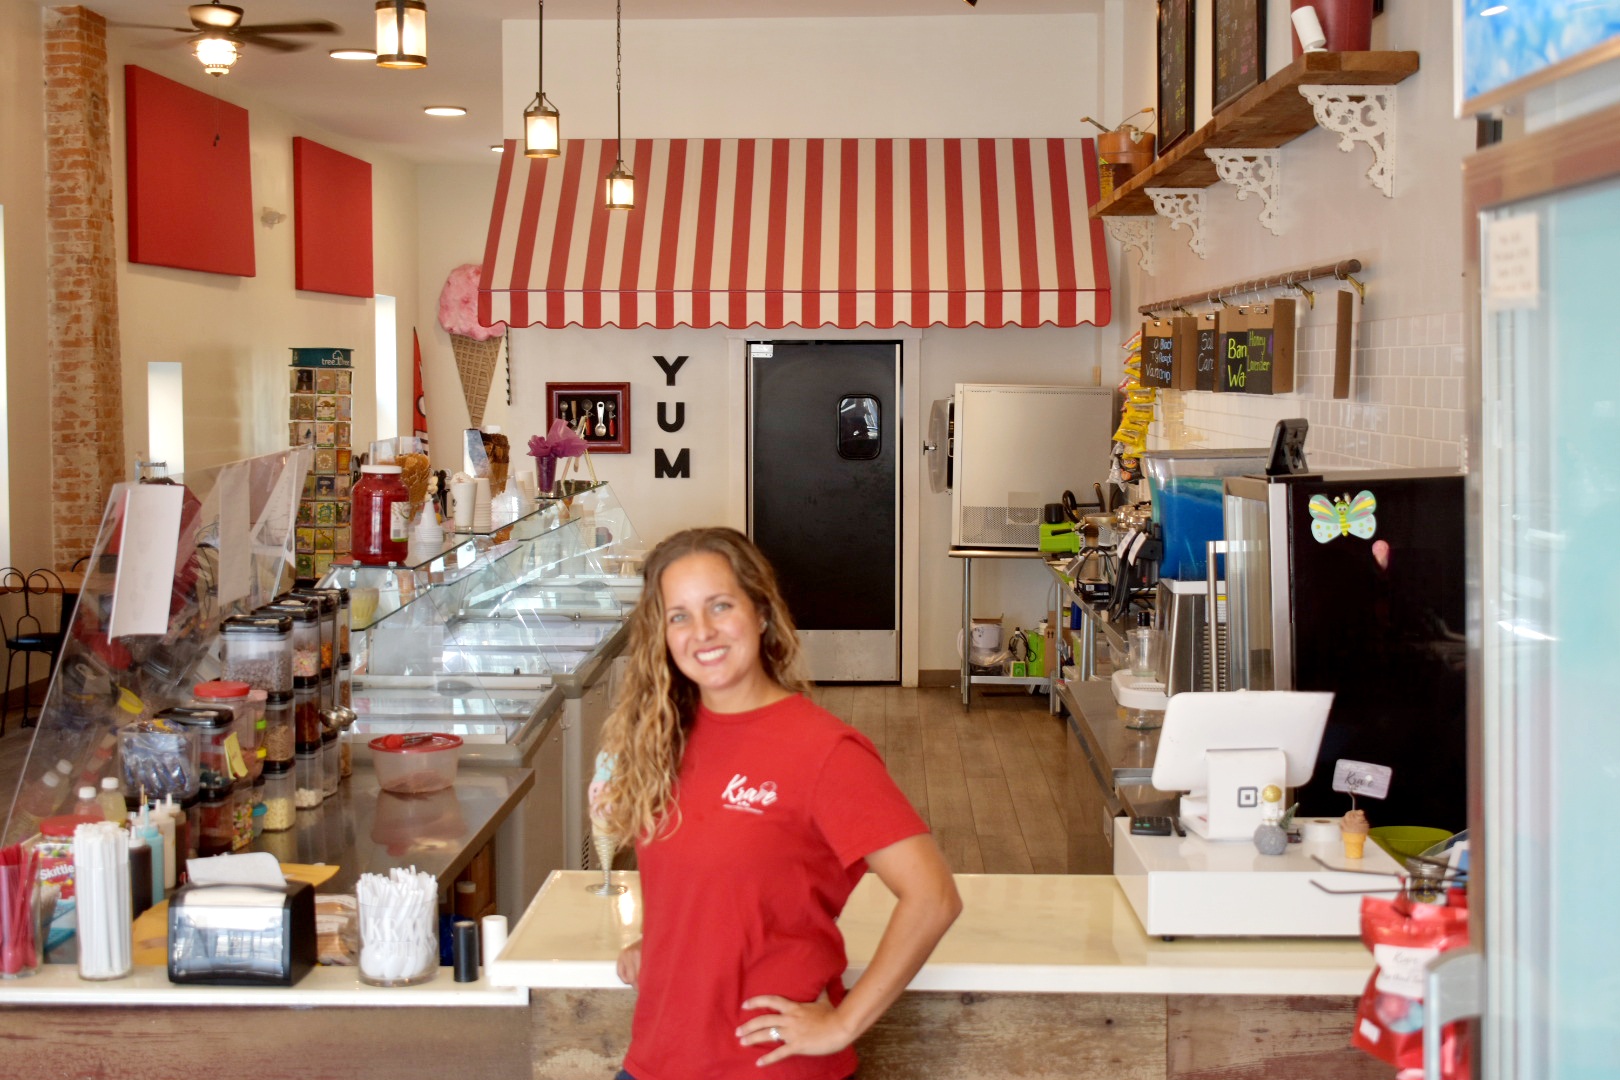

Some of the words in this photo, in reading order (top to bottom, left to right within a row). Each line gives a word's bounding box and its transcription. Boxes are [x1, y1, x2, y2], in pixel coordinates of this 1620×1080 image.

[1228, 338, 1247, 359] Ban
[652, 355, 690, 479] YUM
[1344, 770, 1375, 788] Krae
